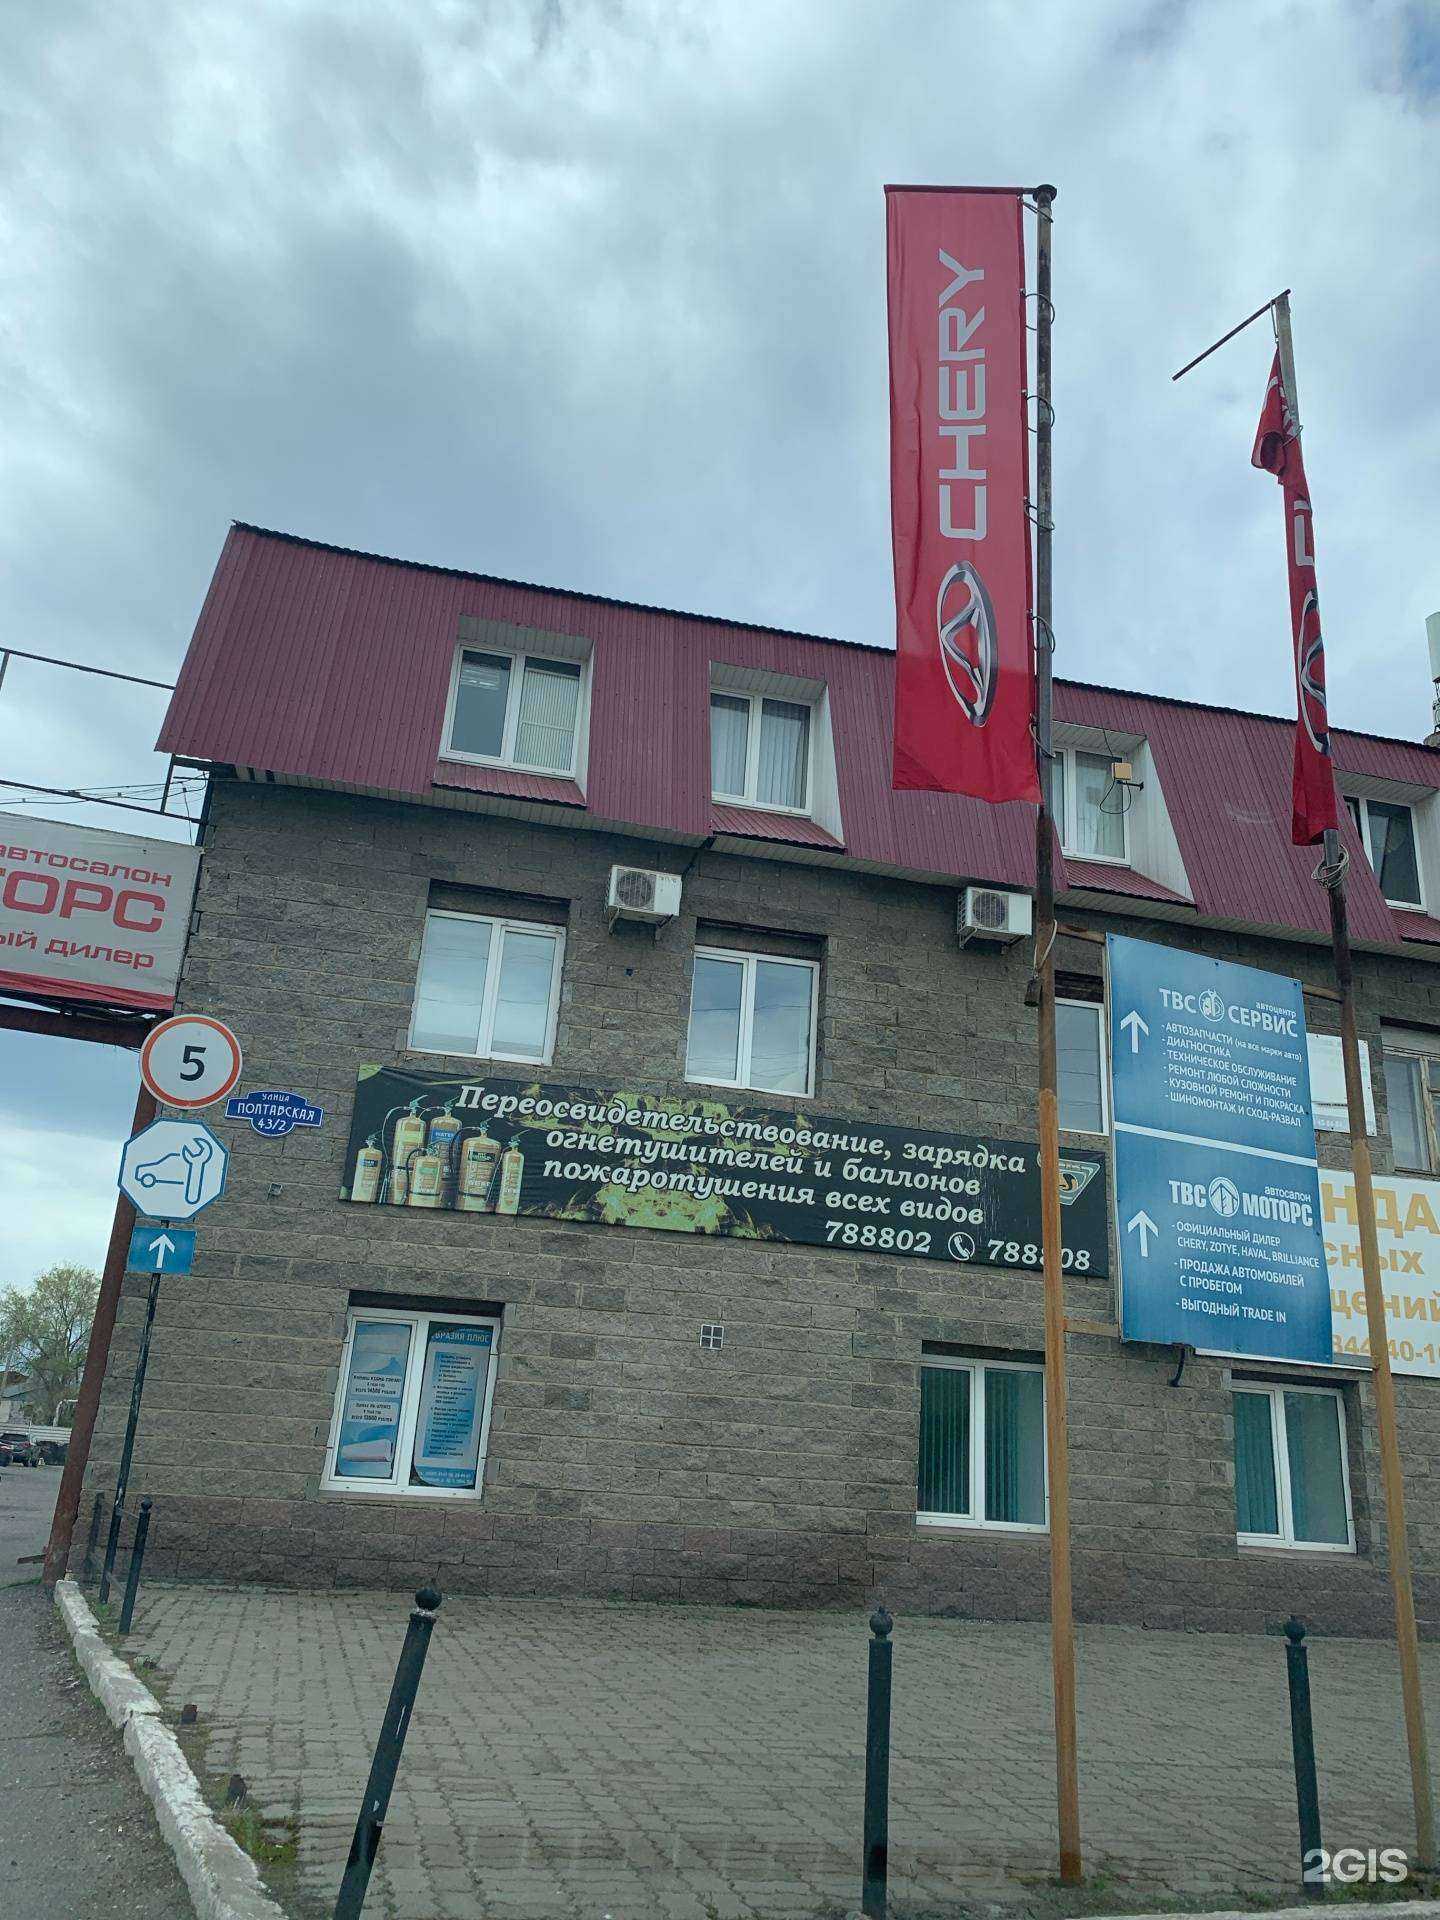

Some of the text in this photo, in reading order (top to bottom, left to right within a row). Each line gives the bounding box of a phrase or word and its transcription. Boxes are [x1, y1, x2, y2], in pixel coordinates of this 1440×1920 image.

[938, 248, 987, 540] CHERY
[0, 868, 165, 932] ОРС
[44, 938, 154, 970] дилер
[1158, 987, 1298, 1037] ТВС СЕРВИС
[1255, 1001, 1297, 1018] автоцентр
[180, 1045, 206, 1081] 5
[1231, 1063, 1297, 1086] ОБСЛУЖИВАНИЕ
[1206, 1071, 1239, 1086] ЛЮБОЙ
[1241, 1079, 1291, 1098] СЛОЖНОСТИ
[237, 1102, 315, 1121] ПОЛТАВСКАЯ
[1219, 1088, 1253, 1102] РЕМОНТ
[1255, 1095, 1262, 1105] И
[1263, 1097, 1305, 1115] ПОКРАСКА
[257, 1118, 286, 1131] 43/2
[455, 1085, 1026, 1174] Переосвидетельствование, зарядка
[1238, 1106, 1245, 1115] И
[1246, 1106, 1301, 1127] СХОД-РАЗВАЛ
[546, 1130, 981, 1196] огнетушителей и баллонов
[543, 1158, 985, 1225] пожаротушения всех видов
[1168, 1180, 1313, 1227] ТВС МОТОРС
[1264, 1186, 1311, 1202] автосалон
[824, 1220, 1090, 1270] 788802 78808
[1252, 1234, 1281, 1248] ДИЛЕР
[1272, 1250, 1320, 1268] BRILLIANCE
[1180, 1275, 1243, 1294] С ПРОБЕГОМ
[1231, 1265, 1305, 1287] АВТОМОБИЛЕЙ
[1242, 1306, 1274, 1322] TRADE
[1276, 1311, 1286, 1323] IN
